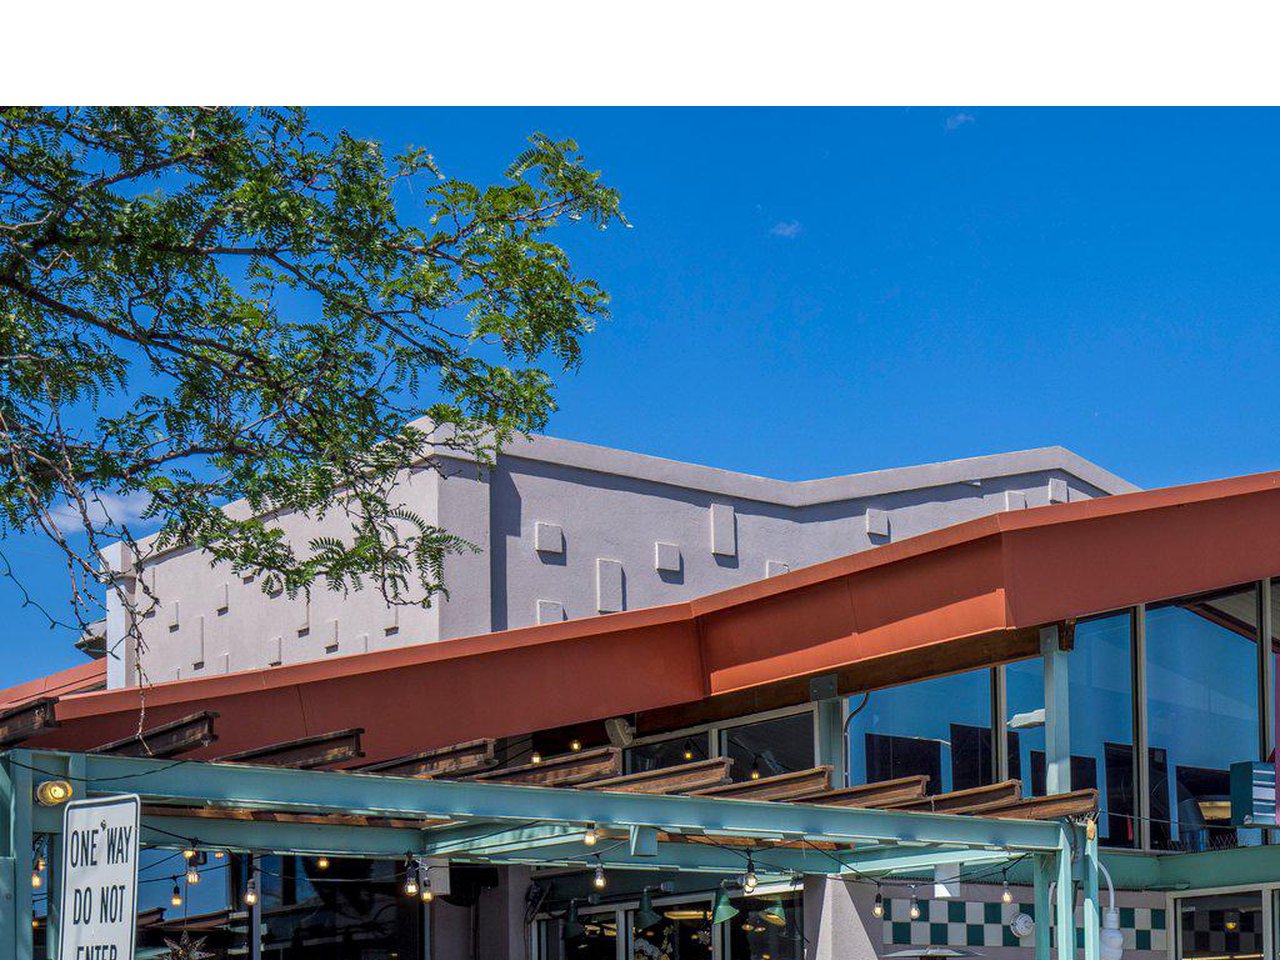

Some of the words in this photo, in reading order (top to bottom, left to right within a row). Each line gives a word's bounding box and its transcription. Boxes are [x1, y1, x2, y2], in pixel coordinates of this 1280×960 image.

[70, 829, 98, 868] ONE
[107, 825, 133, 864] WAY
[73, 886, 92, 925] DO
[100, 885, 126, 923] NOT
